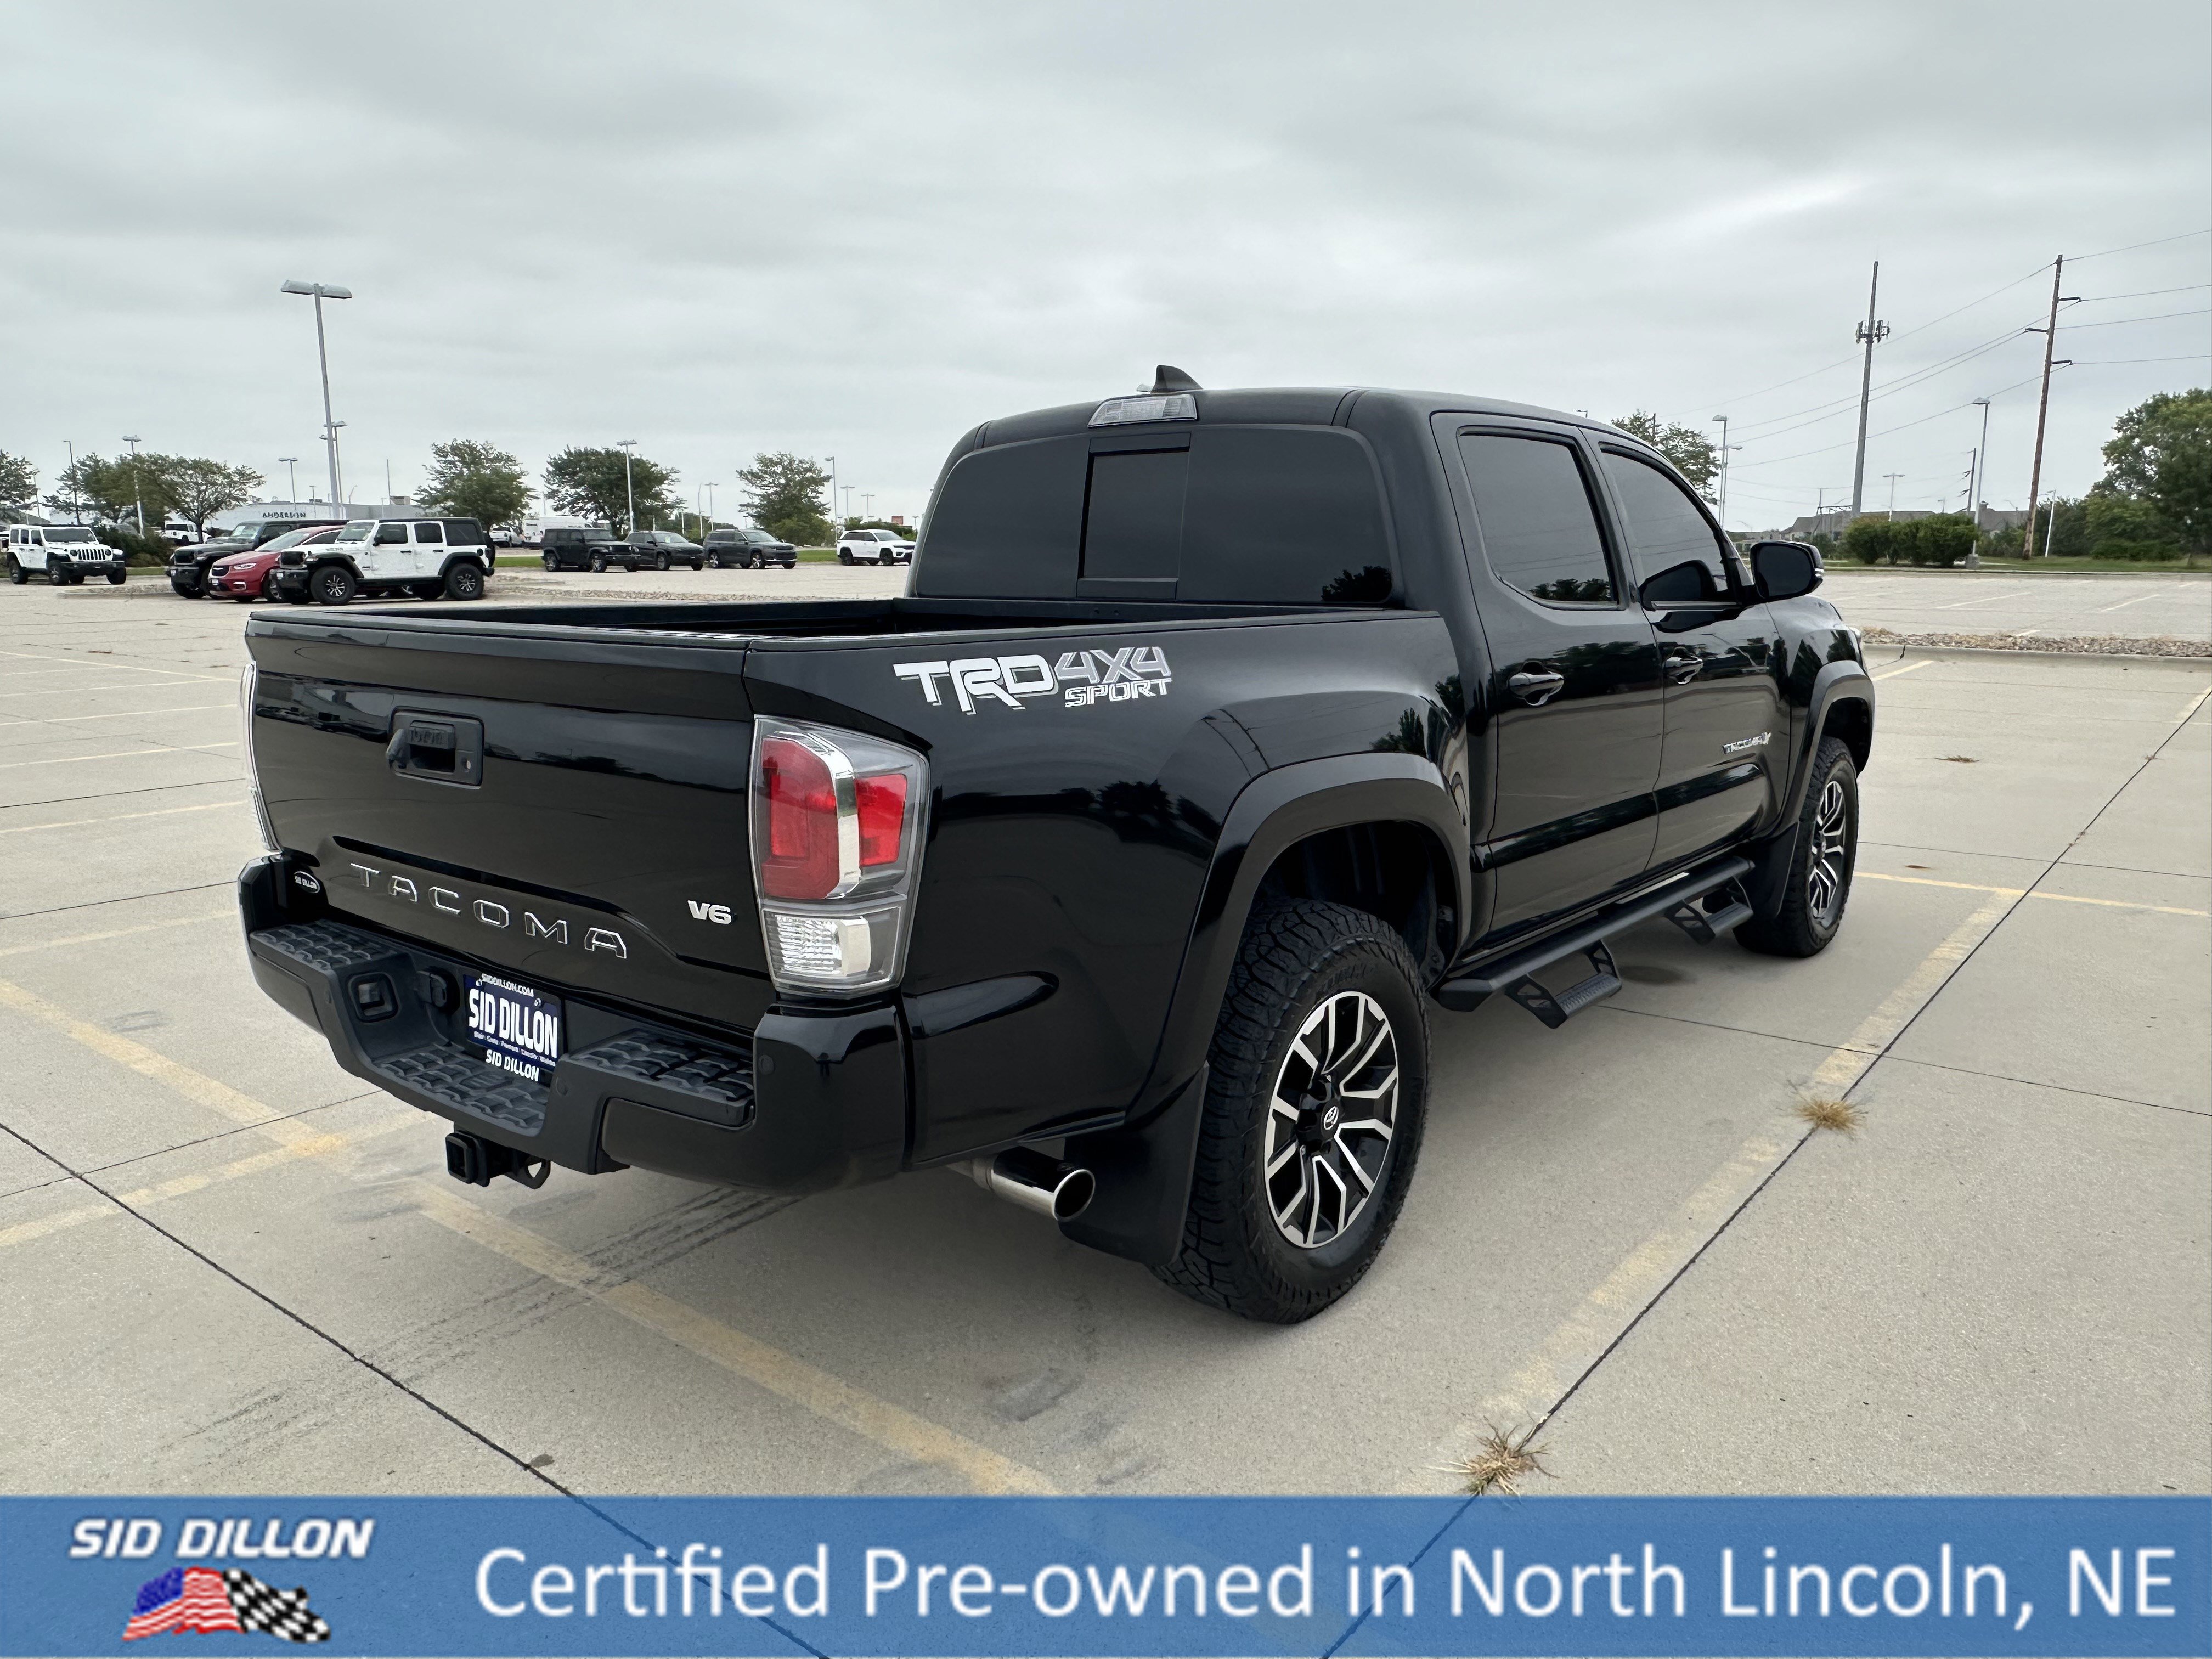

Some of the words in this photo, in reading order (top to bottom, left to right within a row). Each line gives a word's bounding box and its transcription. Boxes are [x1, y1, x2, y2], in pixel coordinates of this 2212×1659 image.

[893, 654, 1058, 715] TRD
[1065, 678, 1172, 708] SPORT
[350, 862, 627, 959] TACOMA
[687, 900, 732, 924] V6
[469, 988, 496, 1035] SID
[499, 997, 558, 1058] DILLON
[486, 1049, 502, 1066] SID
[504, 1058, 539, 1082] DILLON
